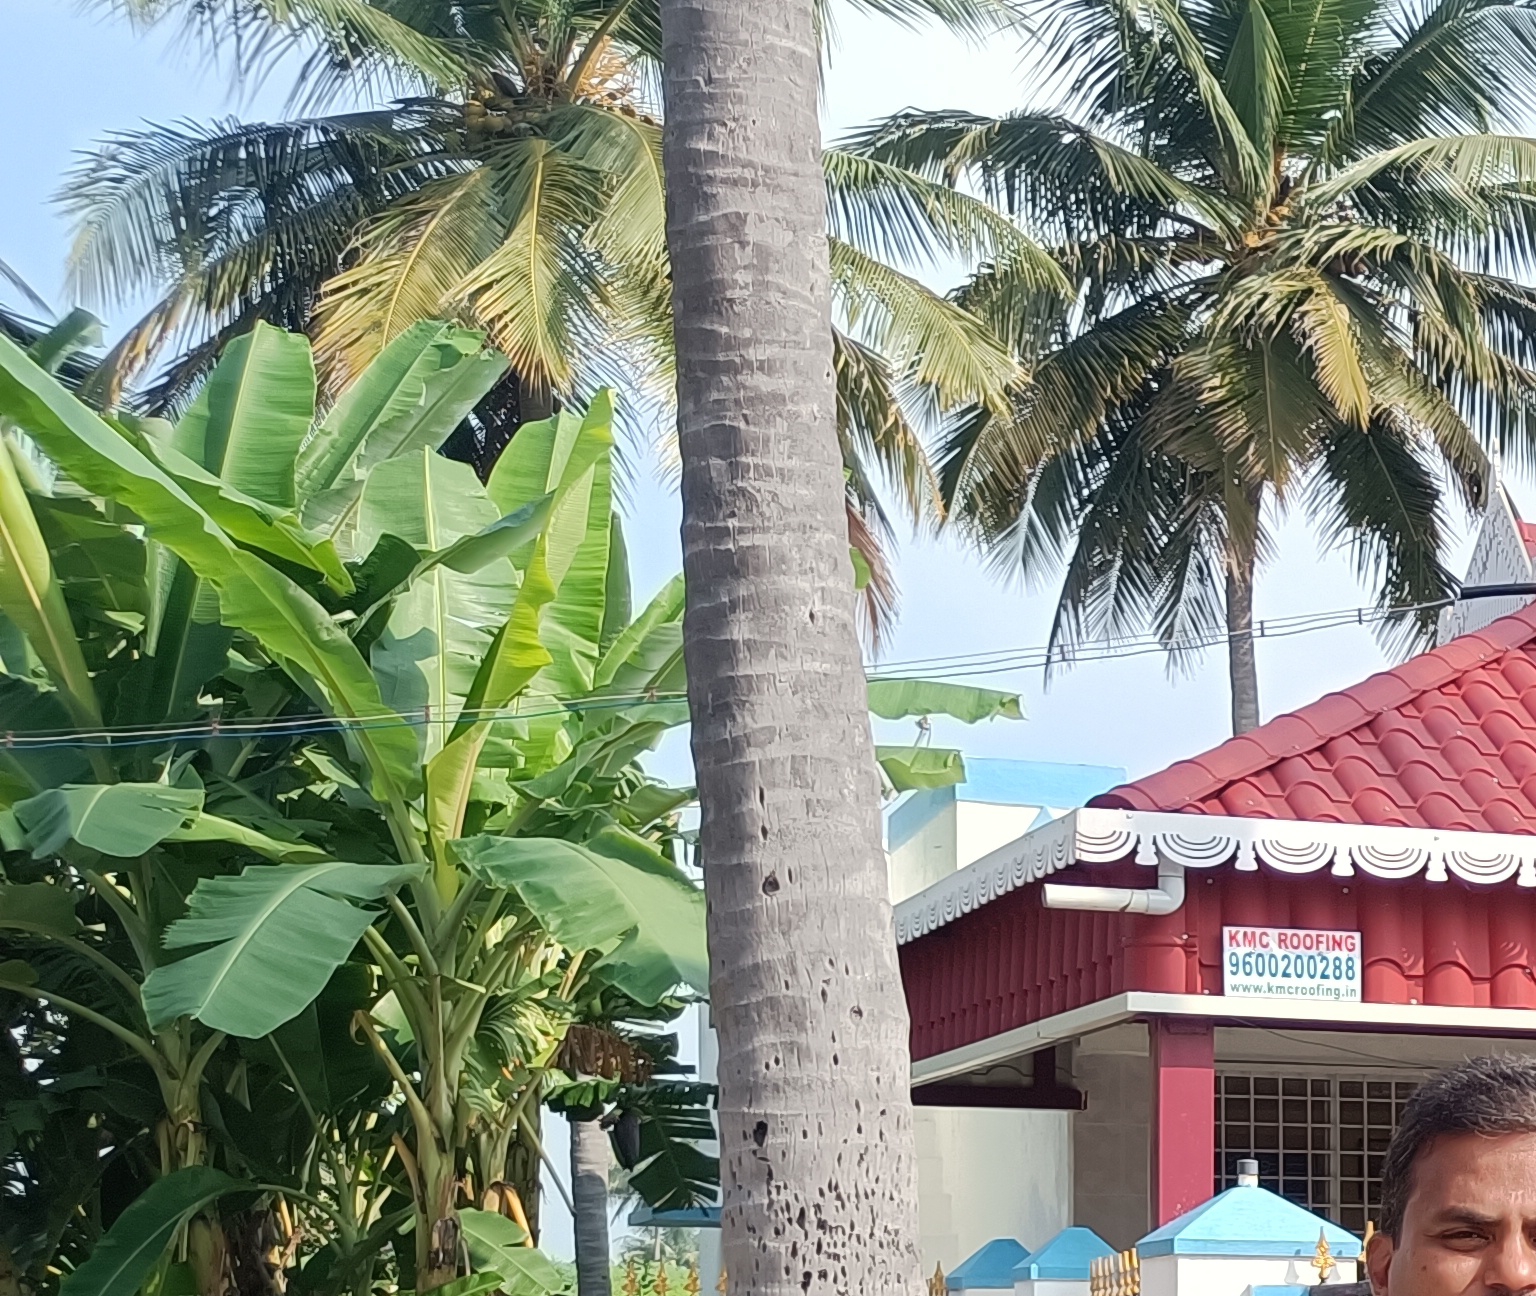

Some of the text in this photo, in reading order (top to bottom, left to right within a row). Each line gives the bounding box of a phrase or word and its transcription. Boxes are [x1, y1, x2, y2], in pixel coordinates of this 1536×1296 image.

[1228, 929, 1357, 953] KMC ROOFING
[1228, 951, 1356, 981] 9600200288
[1230, 982, 1357, 999] www.kmcroofing.in
